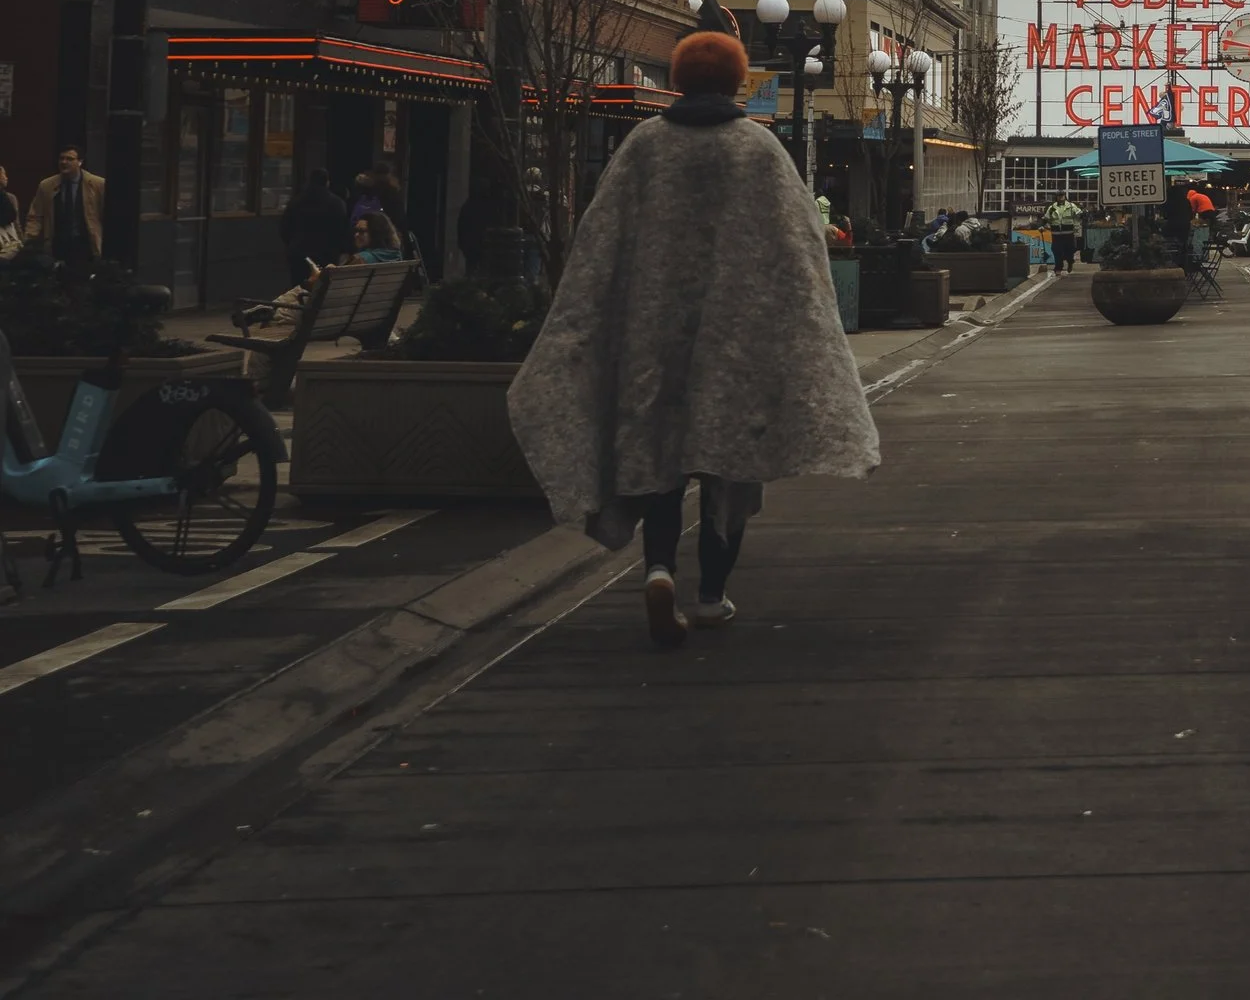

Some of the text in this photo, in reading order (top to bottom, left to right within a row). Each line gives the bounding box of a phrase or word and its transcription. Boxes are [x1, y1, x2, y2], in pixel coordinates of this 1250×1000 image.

[1026, 23, 1219, 71] MARKET
[1102, 129, 1159, 139] PEOPLE STREET
[1108, 169, 1156, 183] STREET
[1109, 185, 1157, 197] CLOSED
[67, 394, 94, 450] BIRD
